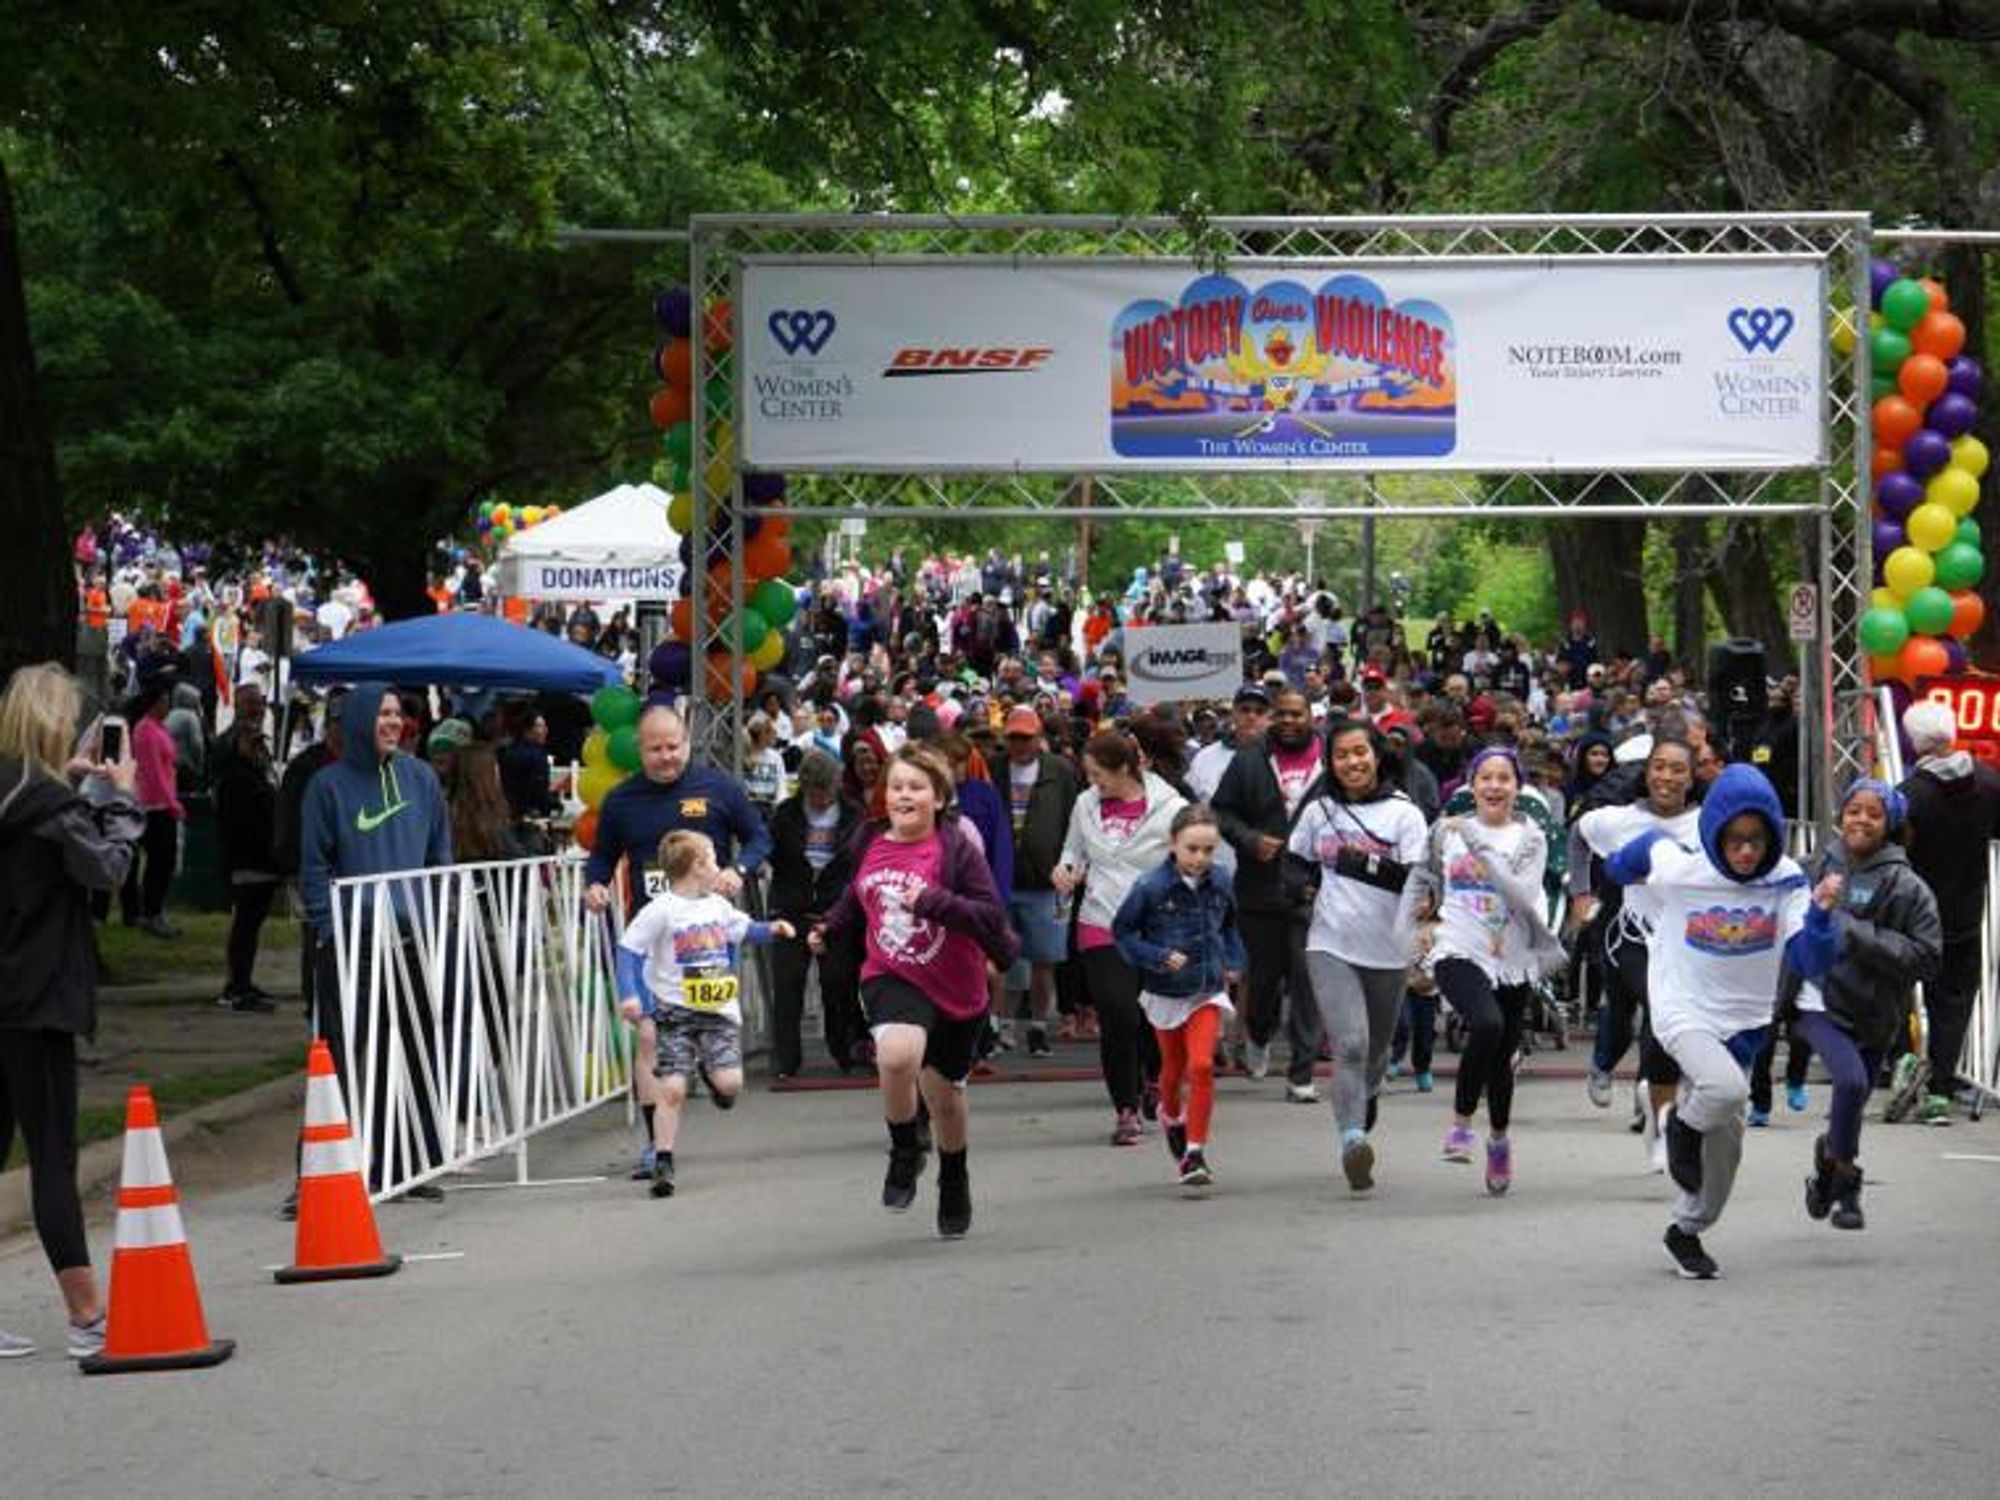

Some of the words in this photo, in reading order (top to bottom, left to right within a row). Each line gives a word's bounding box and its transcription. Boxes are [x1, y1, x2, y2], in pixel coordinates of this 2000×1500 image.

[1123, 295, 1243, 386] VICTORY
[1315, 294, 1444, 388] VIOLENCE
[892, 348, 1053, 367] BNSF
[761, 398, 842, 418] CENTER
[542, 567, 676, 589] DONATIONS
[687, 981, 735, 1003] 1827
